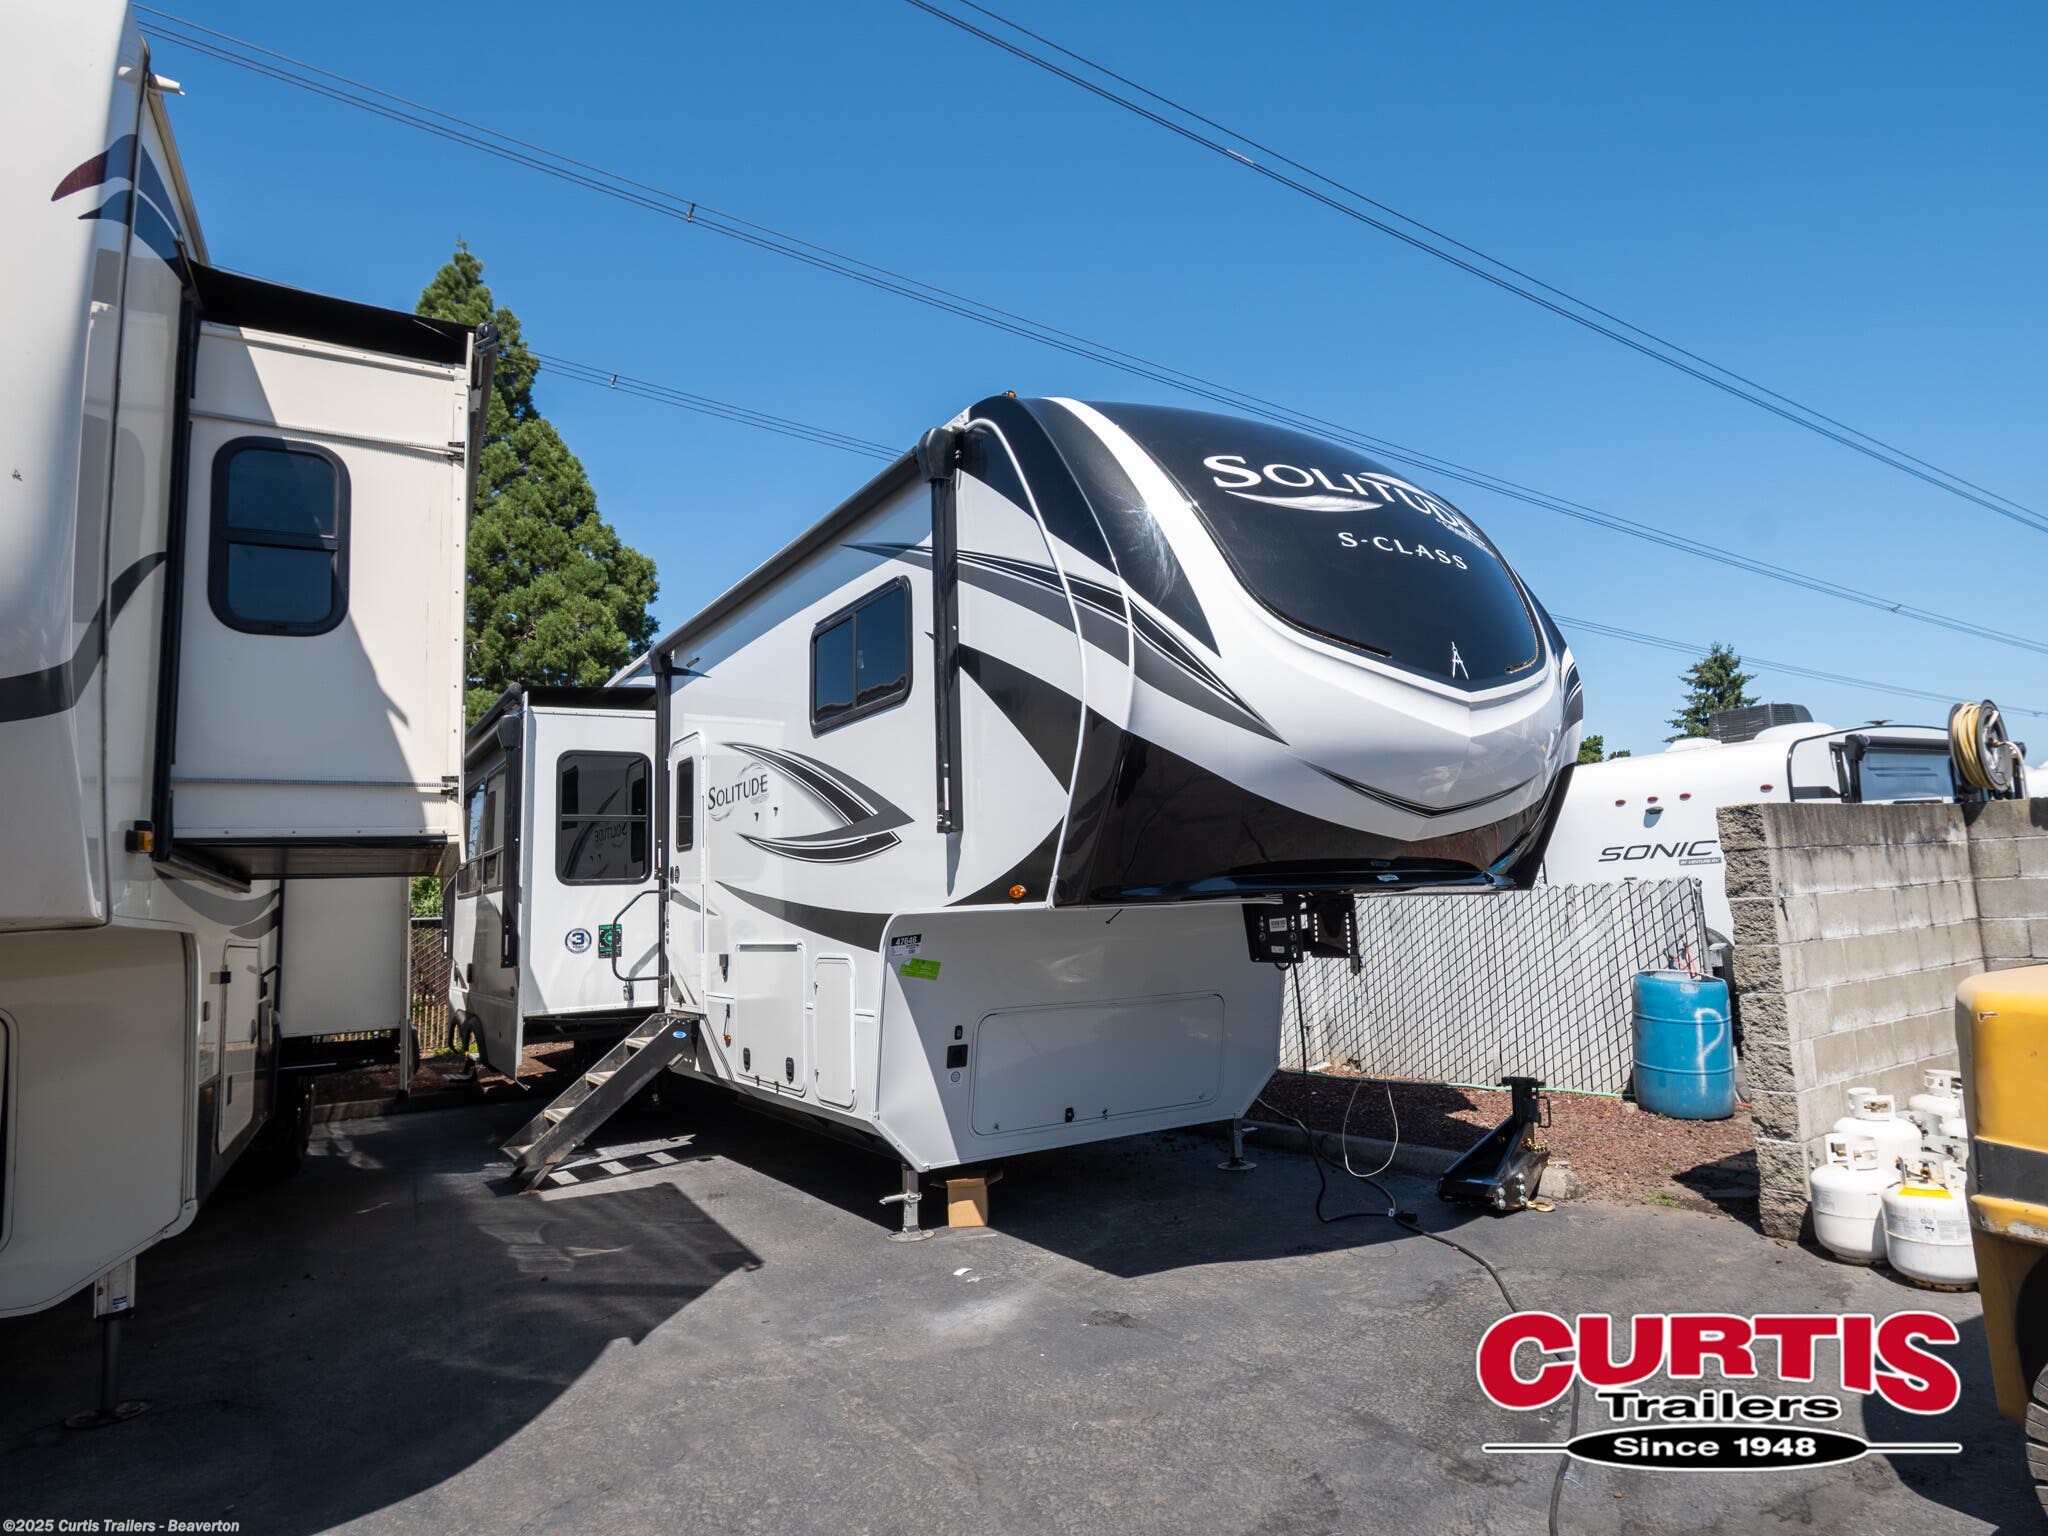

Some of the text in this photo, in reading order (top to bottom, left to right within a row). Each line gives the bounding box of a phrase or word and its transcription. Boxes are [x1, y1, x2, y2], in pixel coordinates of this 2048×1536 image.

[1202, 455, 1486, 546] SOLITUDE
[1338, 532, 1468, 570] S-CLASS
[708, 774, 768, 810] SOLITUDE
[1599, 840, 1718, 862] SONIC
[572, 932, 585, 945] 3
